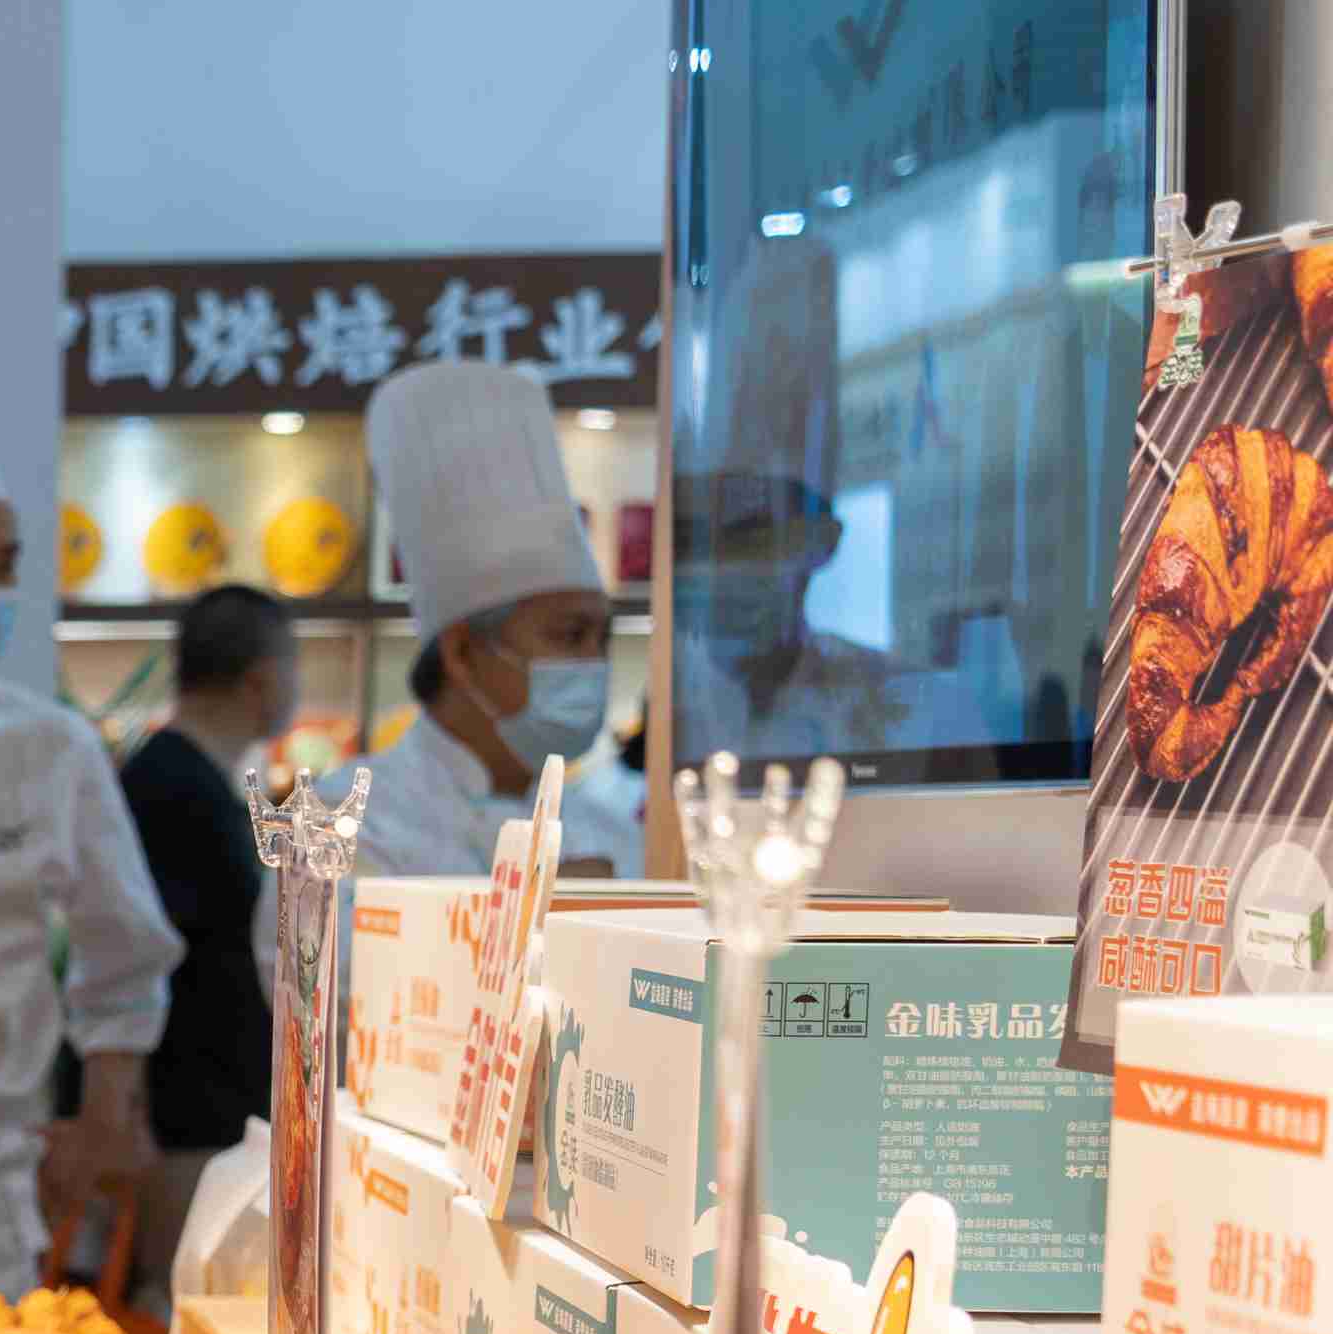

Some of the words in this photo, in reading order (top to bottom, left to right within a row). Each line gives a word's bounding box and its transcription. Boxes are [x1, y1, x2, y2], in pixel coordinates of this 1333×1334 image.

[55, 277, 661, 388] 国烘焙行业
[1105, 857, 1230, 928] 葱香四溢
[1099, 932, 1223, 997] 咸酥可口
[583, 1067, 636, 1132] 乳品发酵油
